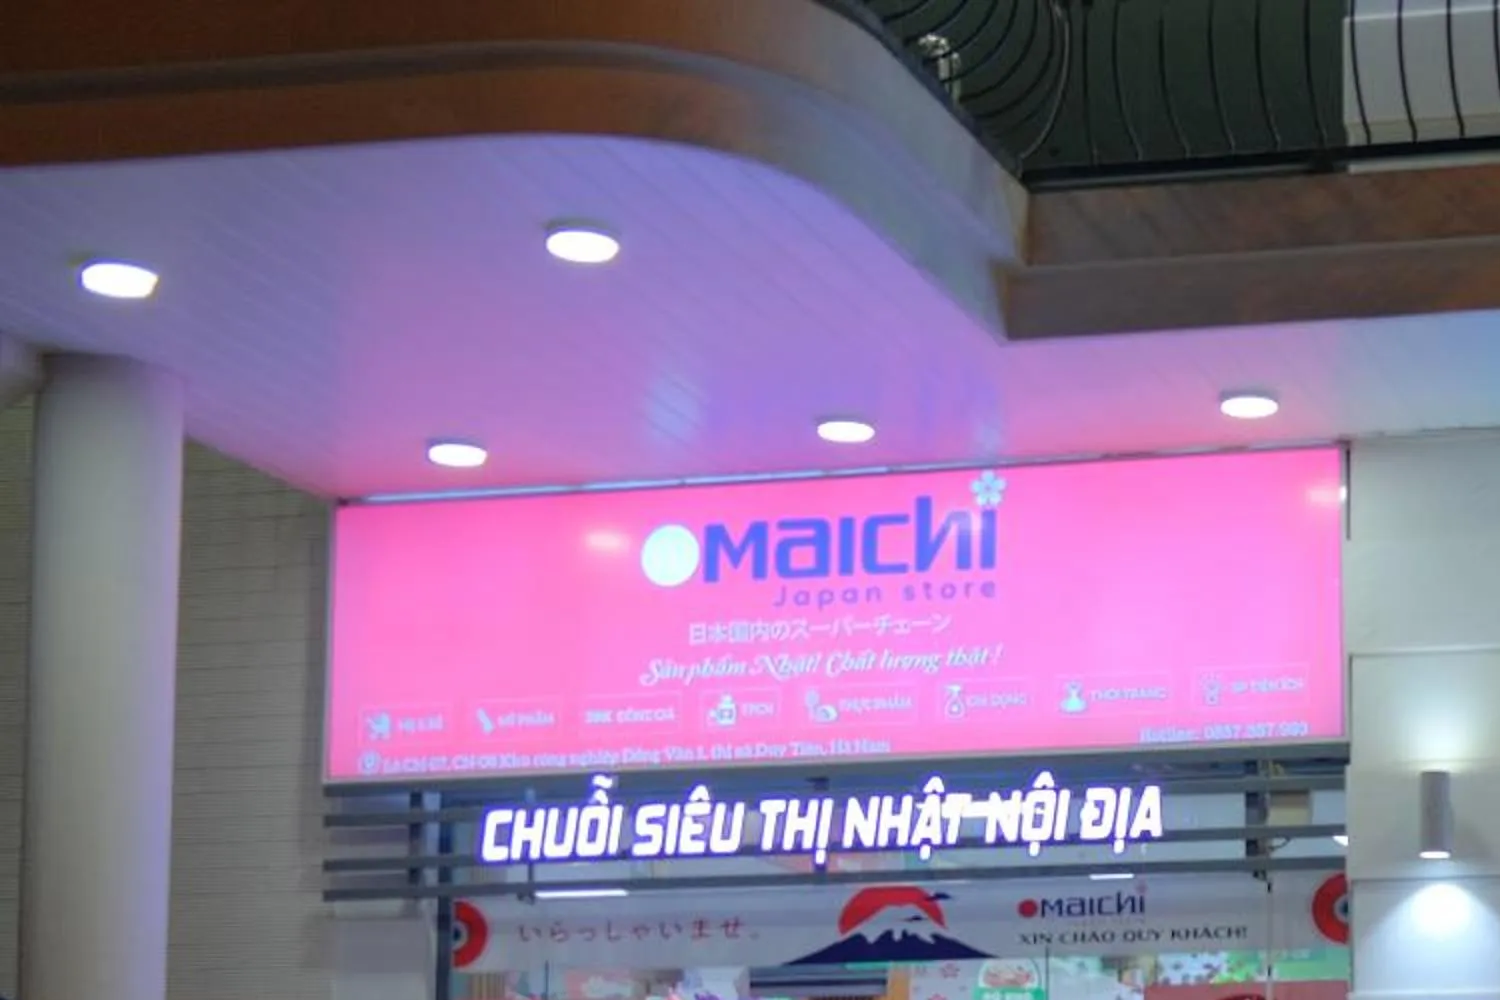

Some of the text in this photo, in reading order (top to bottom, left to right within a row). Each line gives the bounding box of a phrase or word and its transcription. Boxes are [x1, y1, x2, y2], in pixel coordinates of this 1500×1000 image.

[772, 578, 997, 611] Japan store
[480, 771, 1165, 866] CHUỖI SIÊU THỊ NHẬT NỘI ĐỊA
[1040, 886, 1147, 919] Maichi
